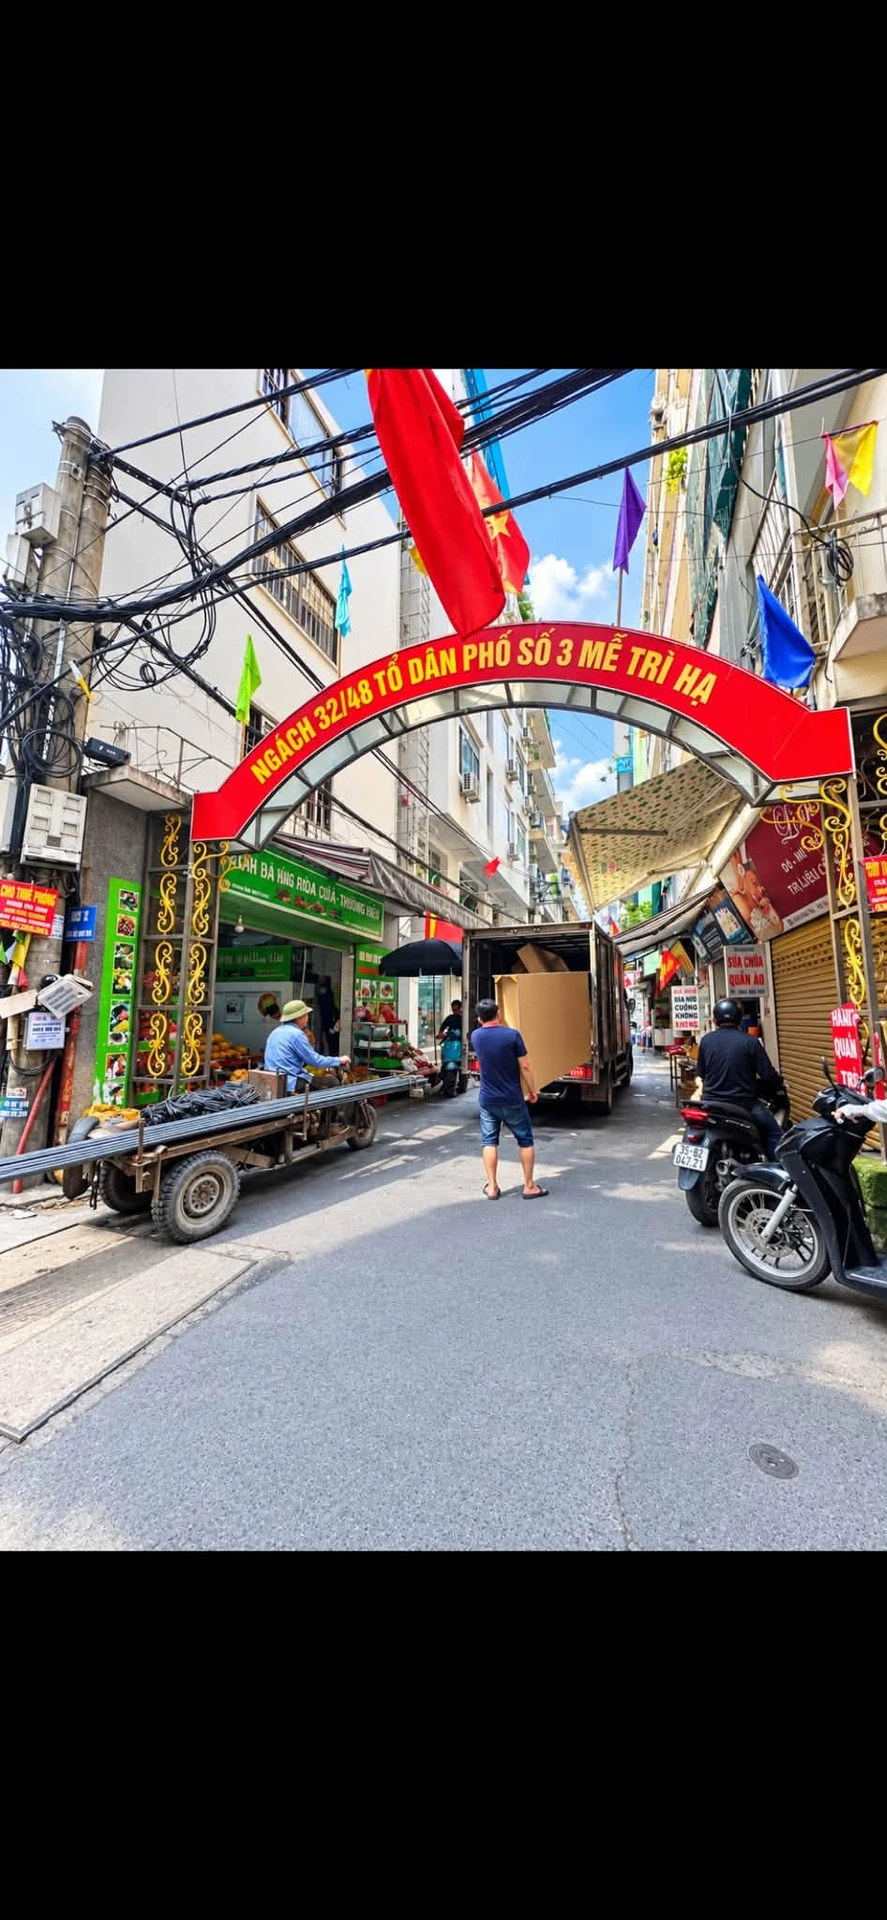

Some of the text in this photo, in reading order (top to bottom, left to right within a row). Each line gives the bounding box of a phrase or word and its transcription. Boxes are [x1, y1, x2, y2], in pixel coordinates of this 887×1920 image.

[250, 626, 718, 785] NGÁCH 32/48 TỔ DÂN PHỐ SỐ 3 MỄ TRÌ HẠ
[675, 1155, 704, 1169] 047.21
